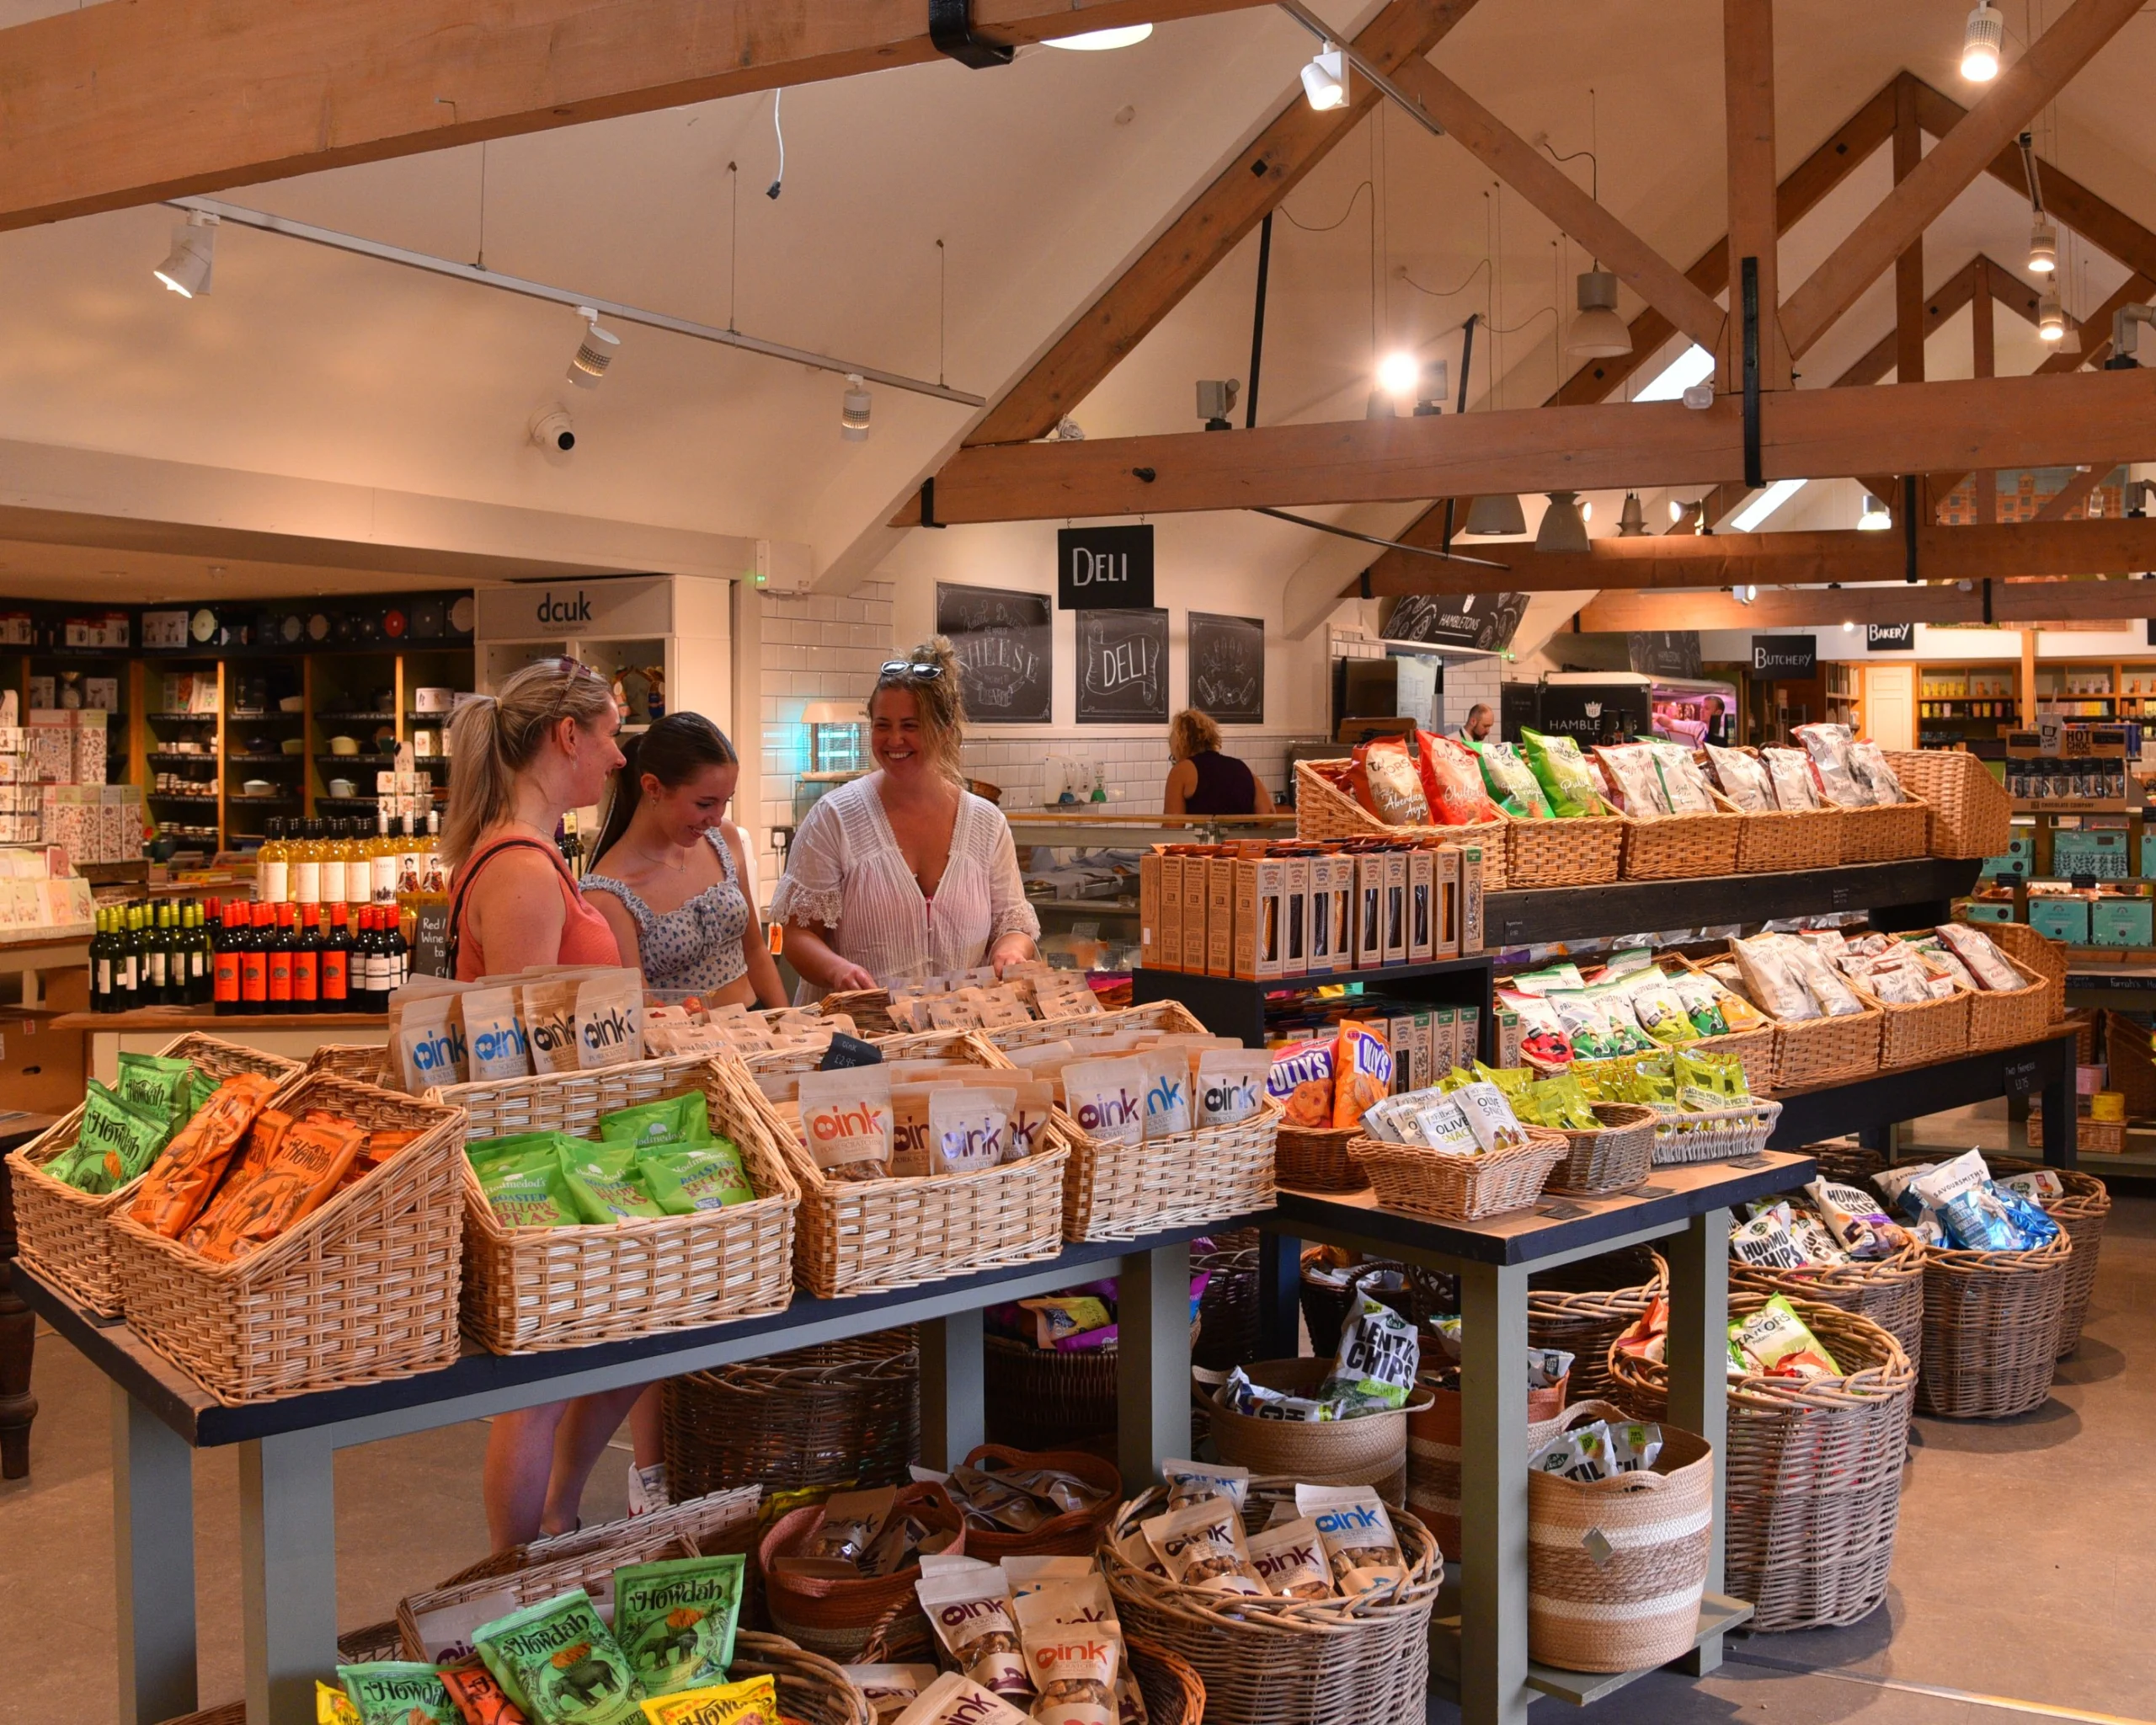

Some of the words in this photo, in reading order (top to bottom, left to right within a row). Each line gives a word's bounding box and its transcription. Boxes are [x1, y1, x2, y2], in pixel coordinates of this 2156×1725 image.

[1073, 547, 1128, 587] DELI
[536, 590, 592, 623] dcuk
[1438, 613, 1481, 631] HAMBLETONS
[1869, 623, 1909, 641] BAKERY
[960, 637, 1040, 683] HEESE
[1103, 638, 1146, 687] DELI
[1755, 647, 1812, 669] BUTCHERY
[2067, 731, 2091, 741] HOT
[2067, 741, 2090, 750] CHOC
[421, 932, 444, 944] Wine
[423, 918, 437, 930] Red
[534, 1012, 575, 1051] oink
[584, 1007, 627, 1049] oink
[413, 1023, 469, 1071] oink
[834, 1055, 856, 1067] £2.95
[1363, 1039, 1388, 1082] OLLY'S
[1269, 1052, 1330, 1092] OLLY'S
[1078, 1088, 1139, 1130] oink
[1147, 1075, 1184, 1116] nk
[1204, 1076, 1257, 1113] oink
[1477, 1097, 1500, 1108] OLIVE
[87, 1109, 140, 1163] Howdah
[813, 1102, 884, 1141] oink
[894, 1115, 930, 1152] oin
[1436, 1117, 1470, 1135] OLIVE
[1442, 1128, 1472, 1144] SNAC
[941, 1117, 1002, 1160] oink
[680, 1160, 735, 1186] ROASTED
[681, 1166, 739, 1192] YELLOW
[688, 1174, 747, 1199] PEAS
[1934, 1168, 1984, 1199] SAVOURSMITHS
[490, 1193, 547, 1204] ROASTED
[492, 1203, 551, 1215] YELLOW
[1827, 1189, 1870, 1203] HUMMU
[1836, 1201, 1881, 1215] CHIP
[495, 1210, 560, 1228] PEAS
[1742, 1229, 1789, 1261] HUMMU
[1355, 1316, 1415, 1367] LENTIL
[1346, 1342, 1412, 1391] CHIPS
[1174, 1472, 1238, 1496] oink
[1315, 1505, 1384, 1533] oink
[1165, 1525, 1234, 1557] oink
[1252, 1546, 1320, 1578] oink
[629, 1578, 723, 1612] Howdah
[941, 1599, 1004, 1626] oink
[504, 1614, 589, 1658] Howdah
[1036, 1640, 1107, 1670] oink
